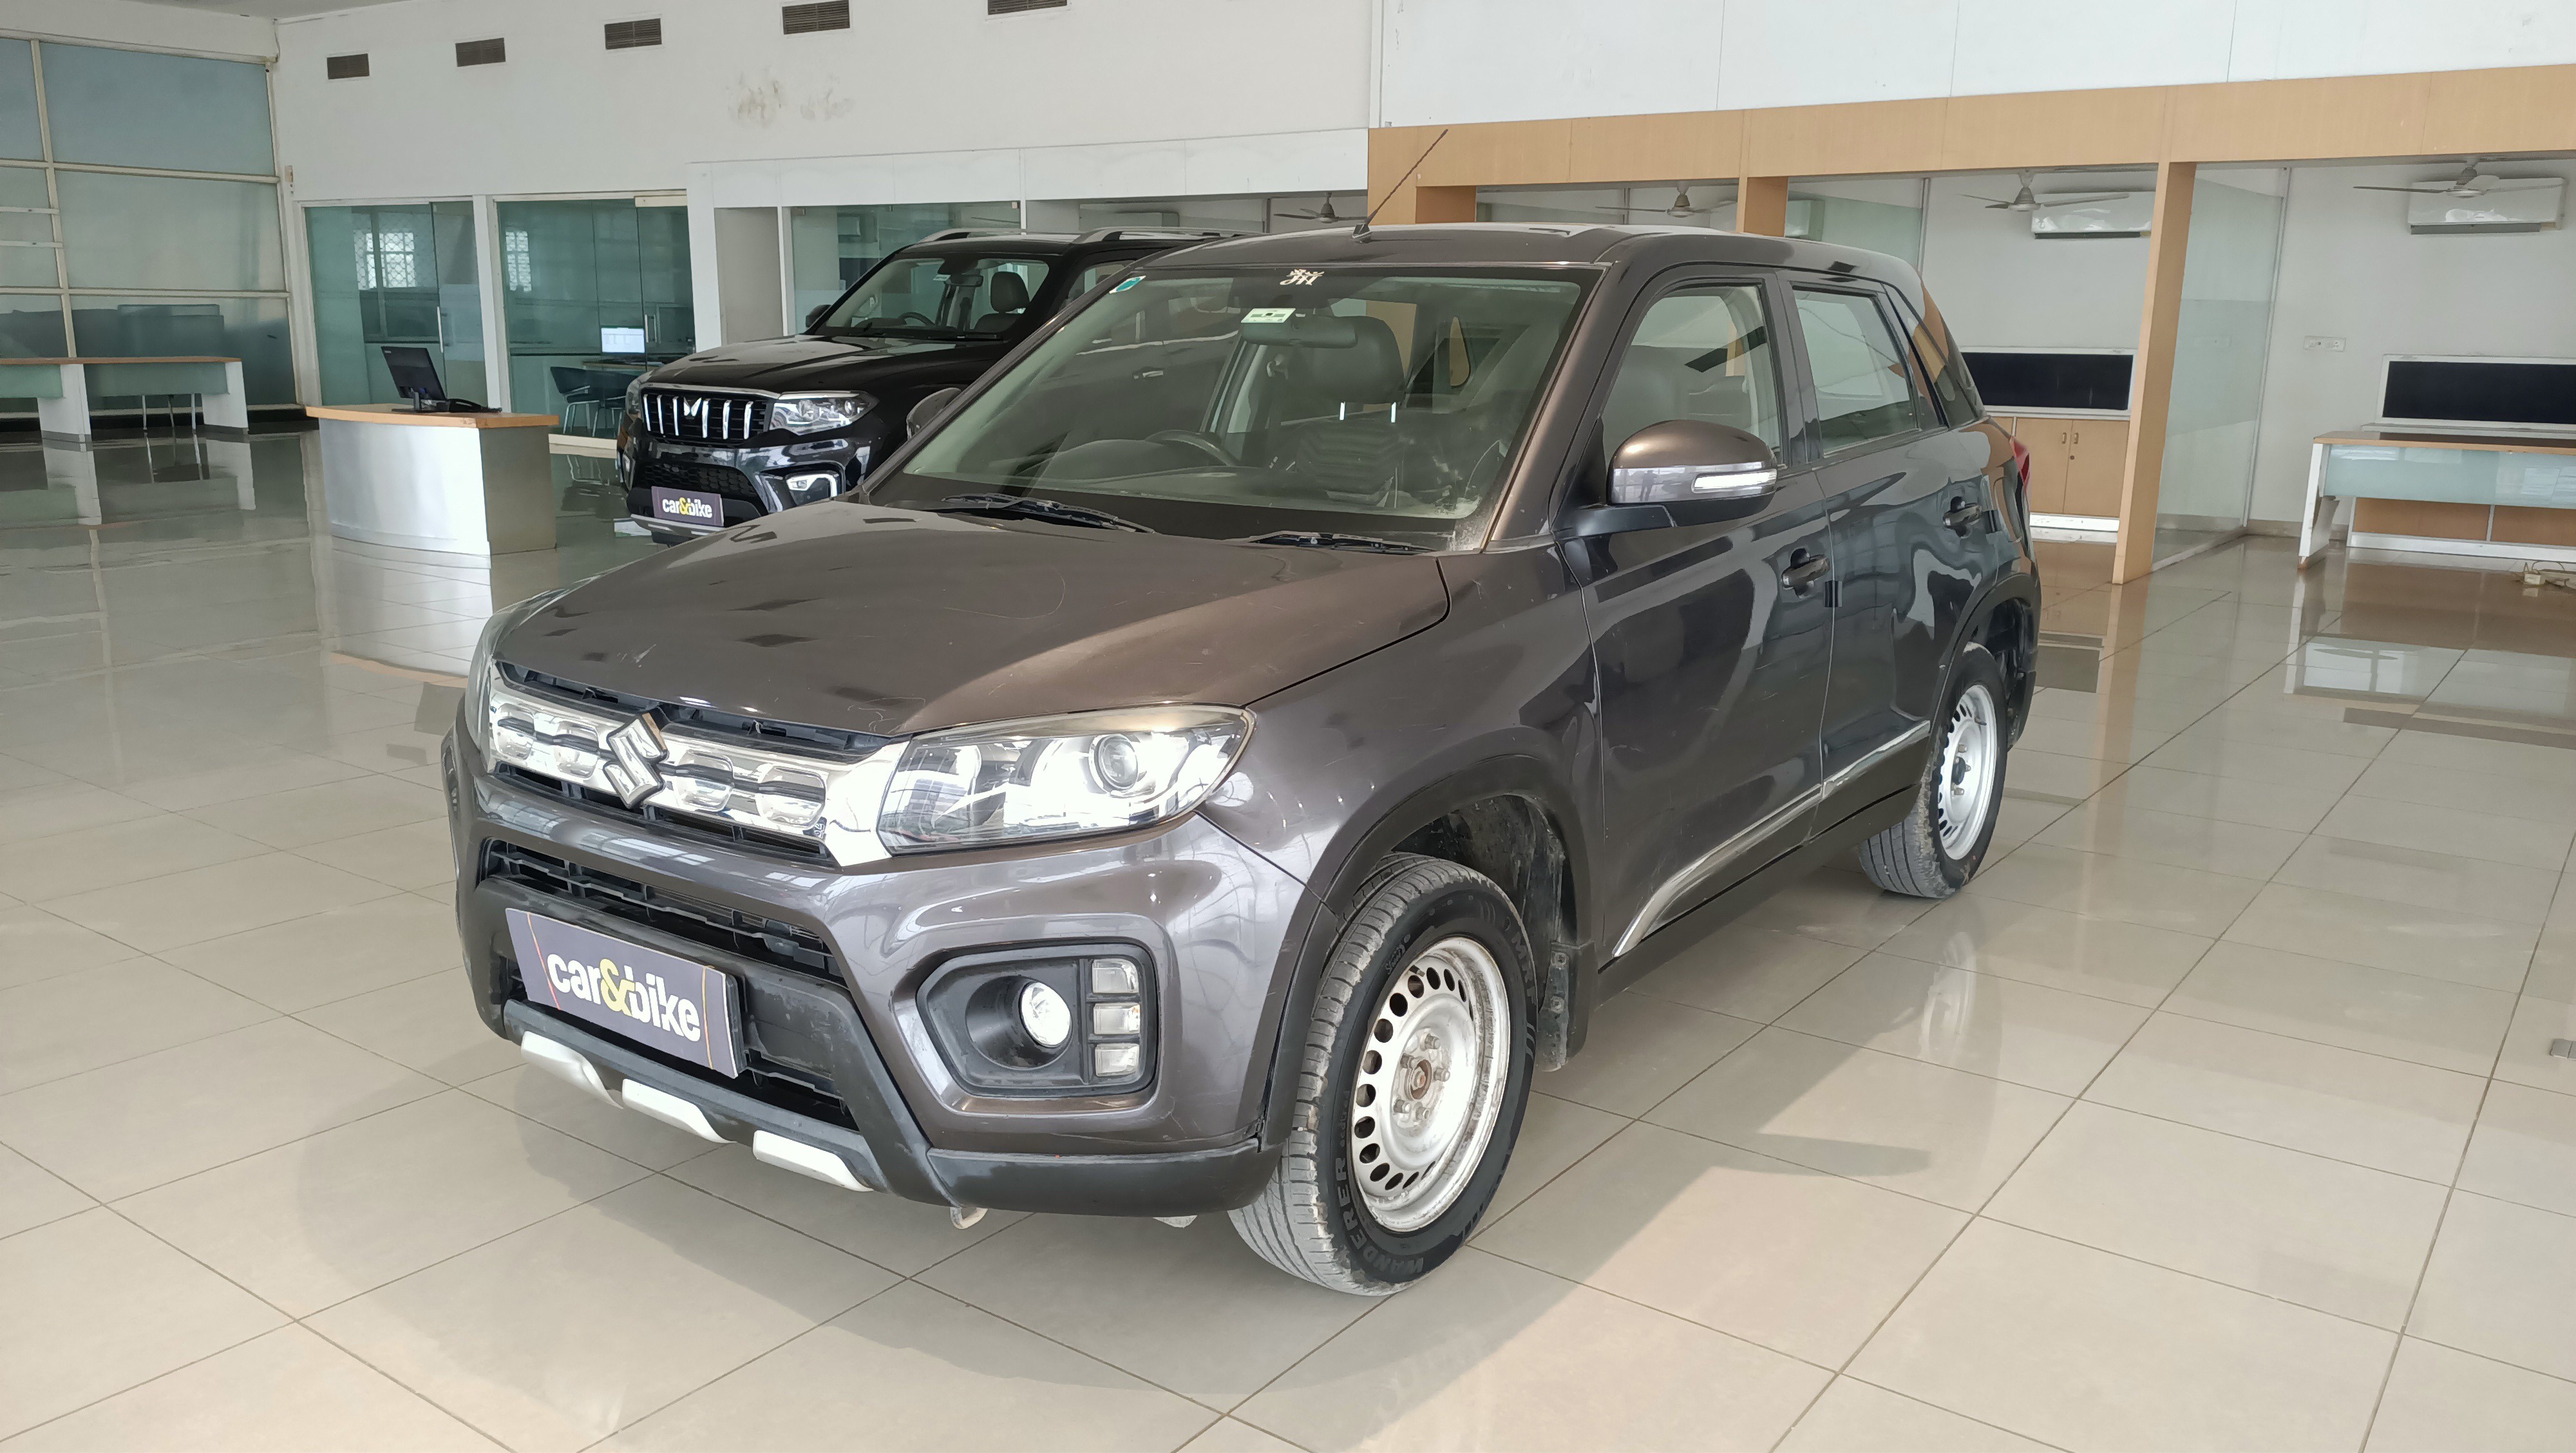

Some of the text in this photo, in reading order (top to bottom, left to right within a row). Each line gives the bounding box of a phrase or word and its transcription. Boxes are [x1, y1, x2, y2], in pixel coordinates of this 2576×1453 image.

[662, 497, 712, 518] car&bike
[547, 954, 701, 1041] car&bike
[1335, 1157, 1423, 1275] WANDERER
